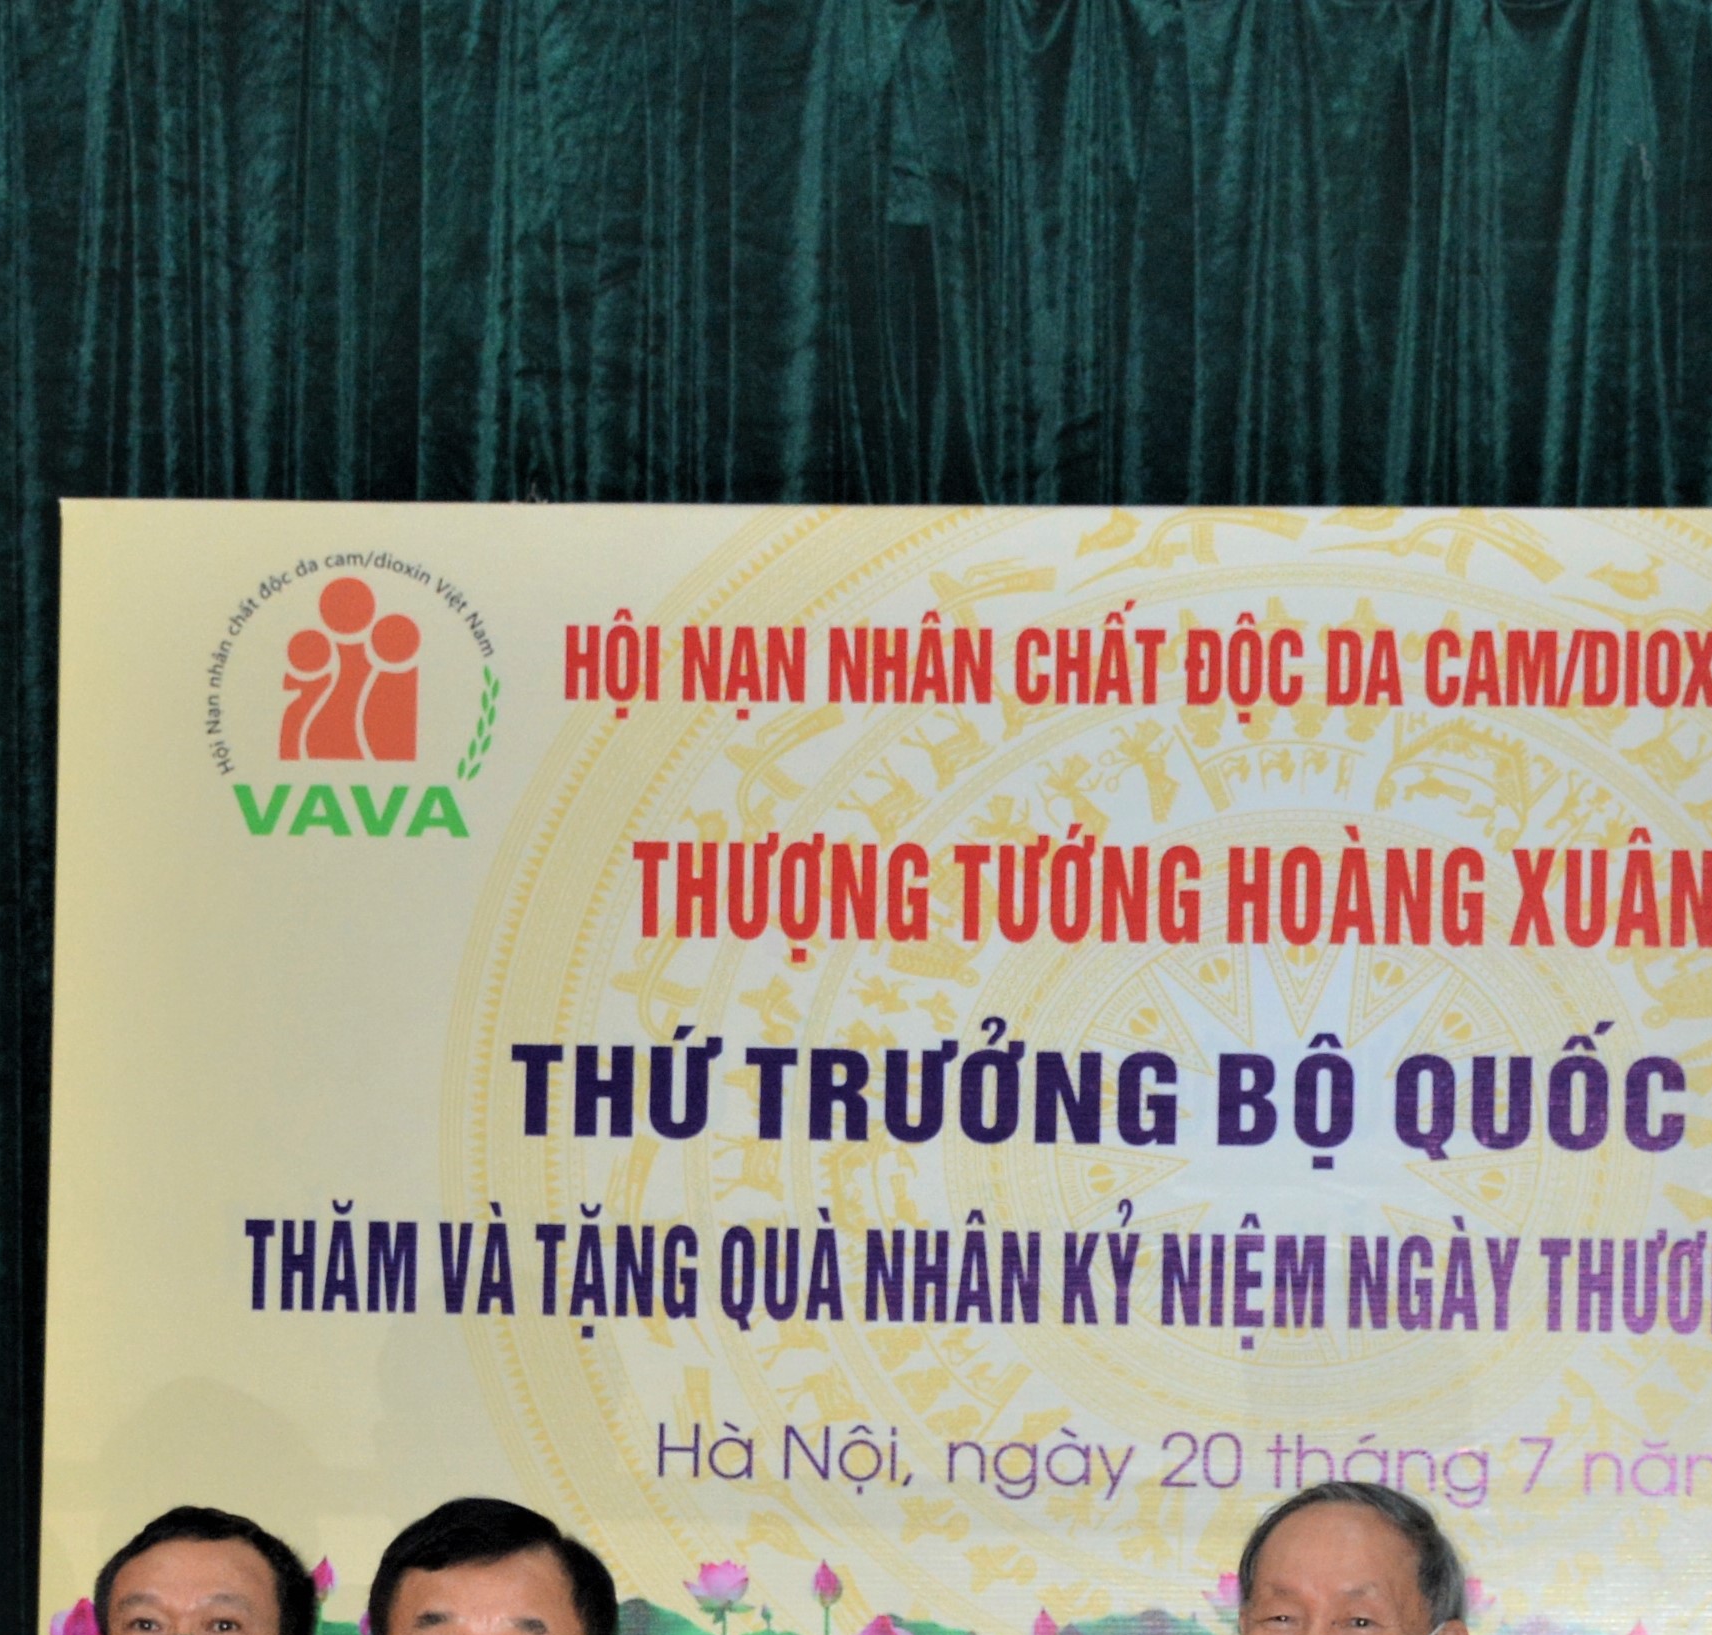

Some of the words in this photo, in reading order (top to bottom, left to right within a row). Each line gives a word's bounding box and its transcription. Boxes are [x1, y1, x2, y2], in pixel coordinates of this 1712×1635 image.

[259, 572, 293, 601] độc
[295, 558, 320, 579] da
[323, 550, 432, 586] cam/dioxin
[464, 611, 496, 659] Nam
[209, 639, 233, 688] nhân
[565, 608, 661, 720] HỘI
[682, 625, 807, 720] NẠN
[828, 610, 993, 704] NHÂN
[1015, 599, 1166, 705] CHẤT
[1185, 612, 1304, 724] ĐỘC
[1326, 628, 1403, 706] DA
[212, 740, 236, 776] Hội
[231, 783, 471, 838] VAVA
[633, 832, 930, 963] THƯỢNG
[954, 823, 1201, 944] TƯỚNG
[1227, 825, 1485, 947] HOÀNG
[512, 1025, 723, 1141] THỨ
[745, 1016, 1179, 1147] TRƯỞNG
[1217, 1033, 1355, 1170] BỘ
[1394, 1020, 1687, 1161] QUỐC
[245, 1200, 418, 1313] THĂM
[439, 1203, 515, 1315] VÀ
[537, 1203, 699, 1339] TẶNG
[721, 1207, 844, 1331] QUÀ
[865, 1210, 1041, 1325] NHÂN
[1062, 1198, 1141, 1326] KỶ
[1161, 1213, 1327, 1350] NIỆM
[1347, 1215, 1520, 1332] NGÀY
[656, 1421, 755, 1480] Hà
[783, 1424, 916, 1495] Nội,
[947, 1425, 1135, 1502] ngày
[1160, 1431, 1243, 1489] 20
[1266, 1433, 1490, 1510] tháng
[1519, 1437, 1555, 1494] 7
